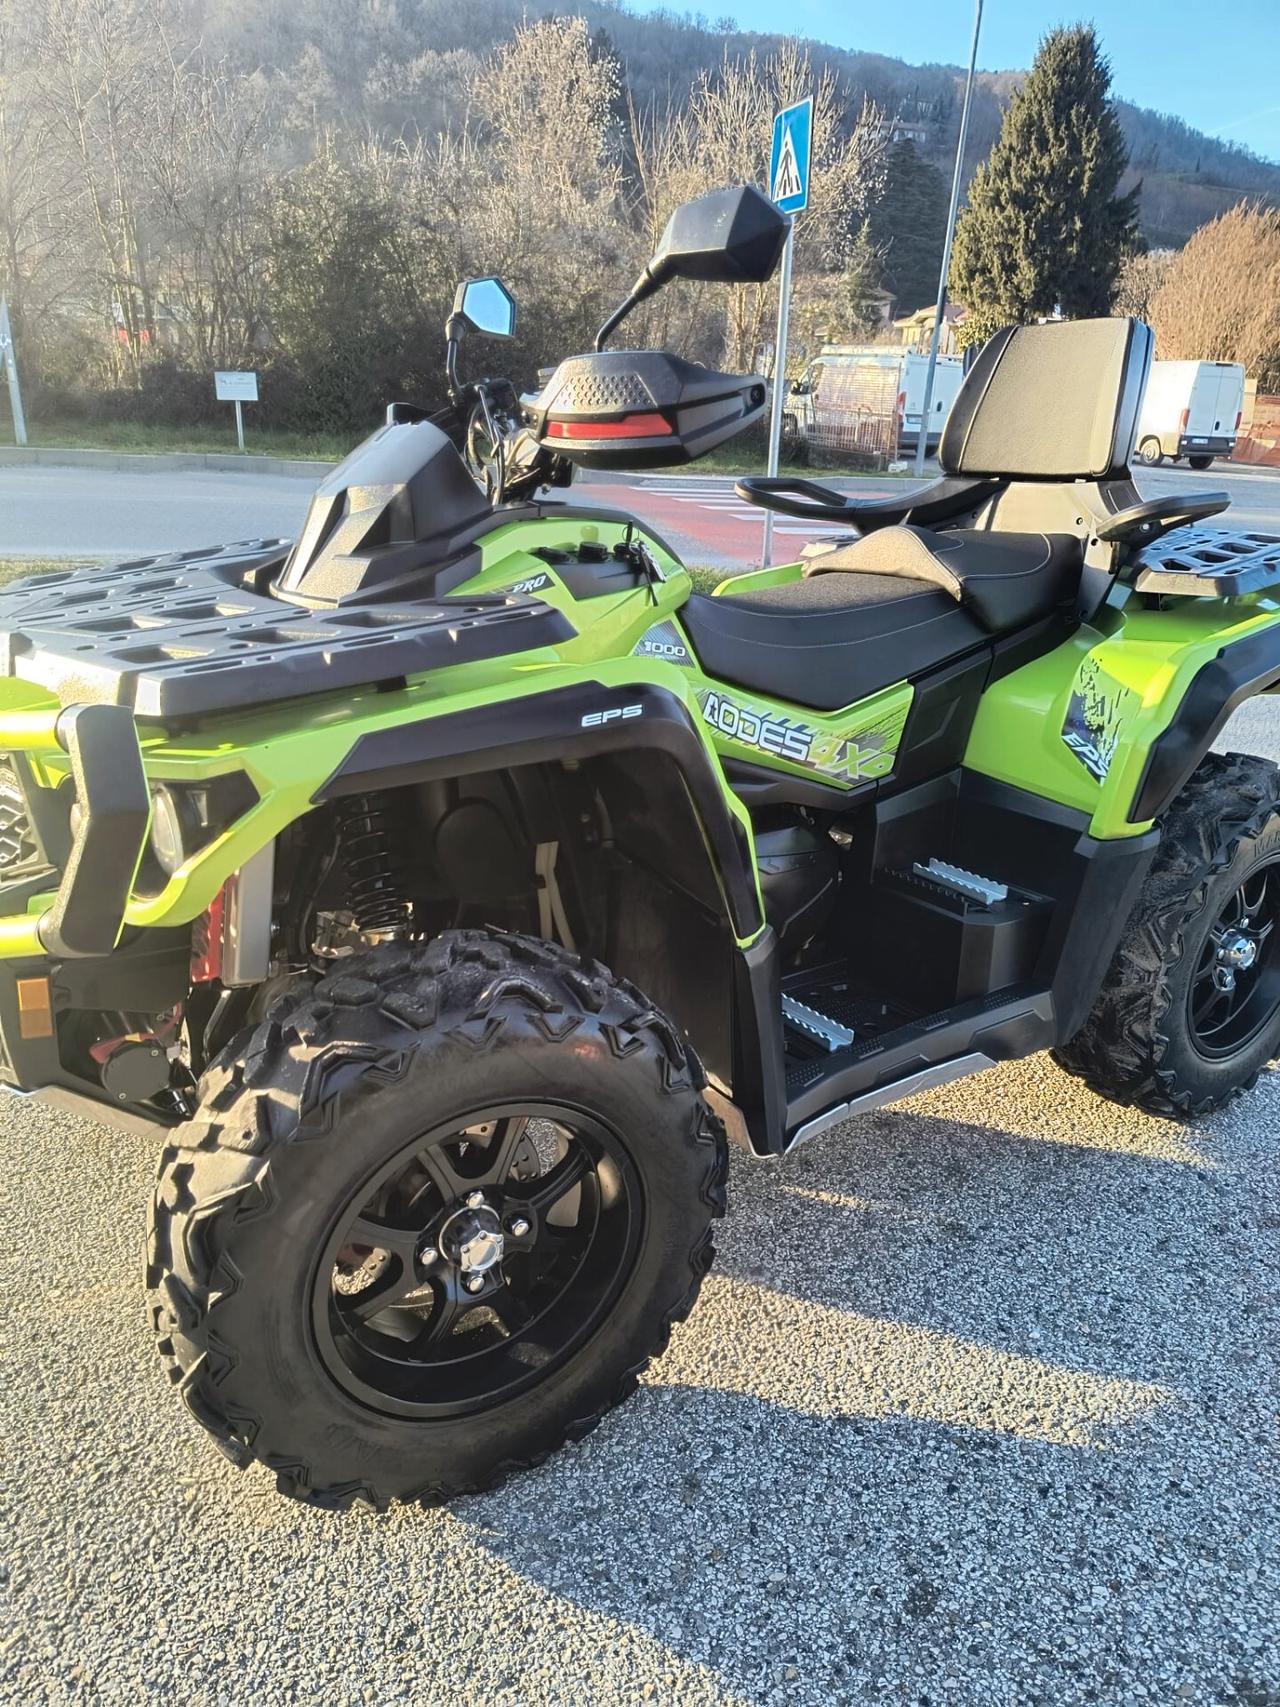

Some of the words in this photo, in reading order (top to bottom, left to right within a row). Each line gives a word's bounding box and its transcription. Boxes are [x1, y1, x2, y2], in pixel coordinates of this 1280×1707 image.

[512, 575, 547, 593] PRO
[644, 641, 686, 657] 1000
[581, 704, 643, 728] EPS
[703, 692, 813, 762] AODES
